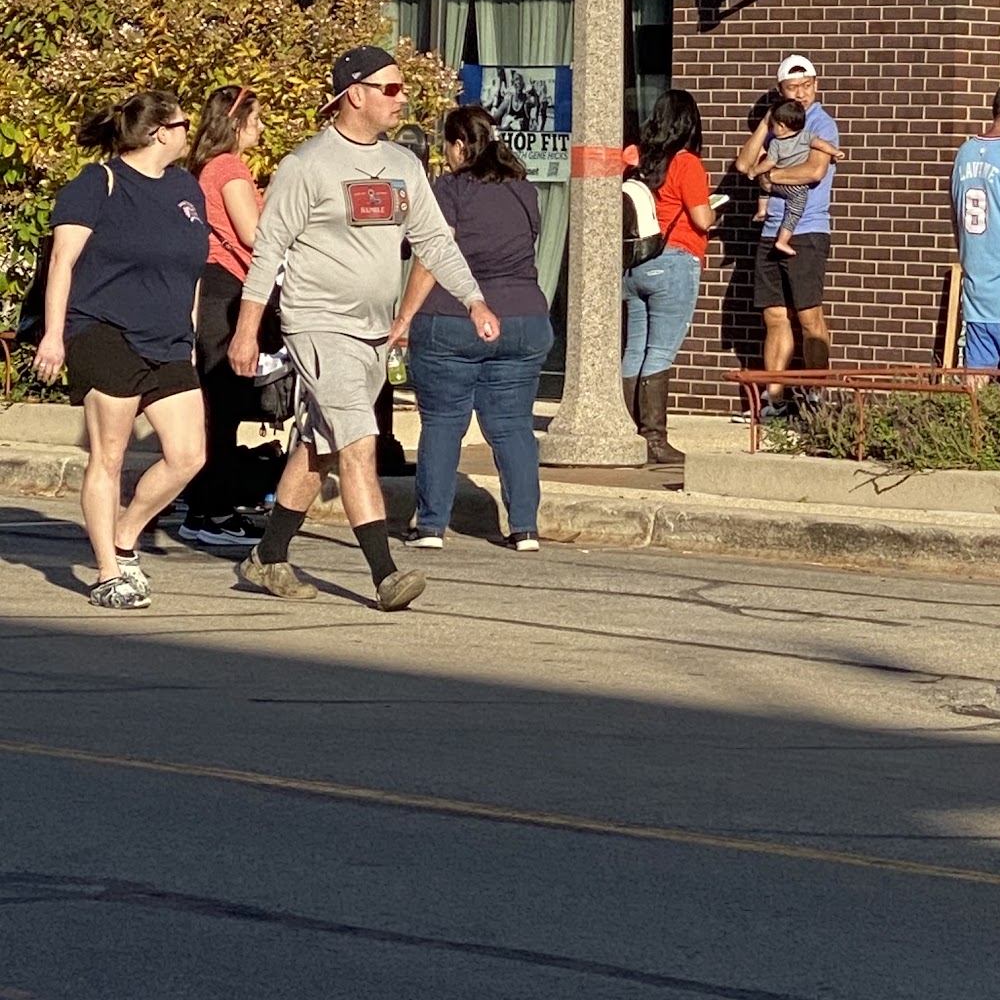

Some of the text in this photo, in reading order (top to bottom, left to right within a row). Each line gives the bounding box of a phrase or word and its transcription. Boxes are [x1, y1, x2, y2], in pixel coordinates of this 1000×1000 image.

[501, 132, 570, 151] HOP FIT
[959, 161, 1000, 184] LAVINE
[965, 188, 987, 235] 8
